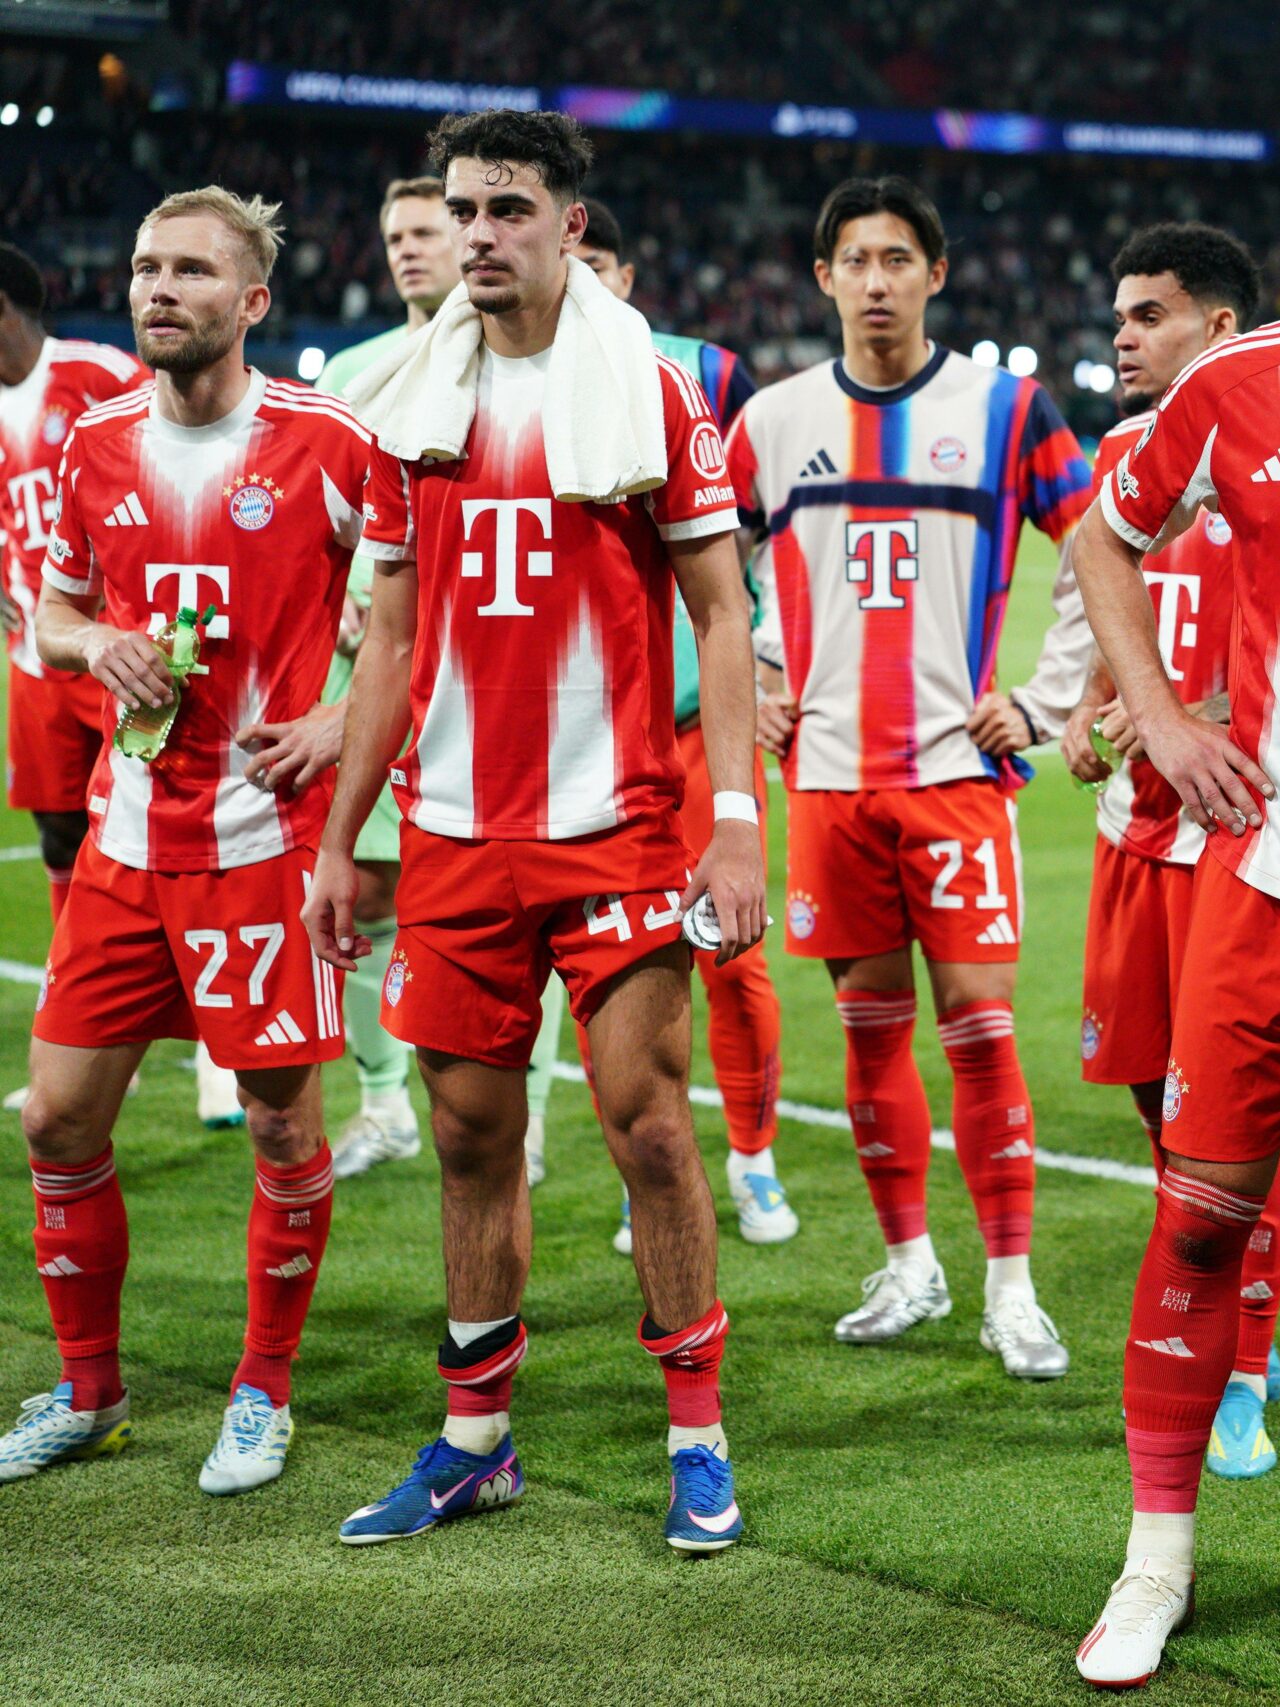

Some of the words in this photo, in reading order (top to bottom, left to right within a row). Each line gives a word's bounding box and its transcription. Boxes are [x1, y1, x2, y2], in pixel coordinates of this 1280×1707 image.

[7, 466, 56, 551] T
[460, 497, 553, 617] T
[845, 518, 919, 610] T
[145, 563, 230, 675] T
[1142, 570, 1201, 681] T
[927, 837, 1008, 909] 21
[184, 922, 285, 1008] 27
